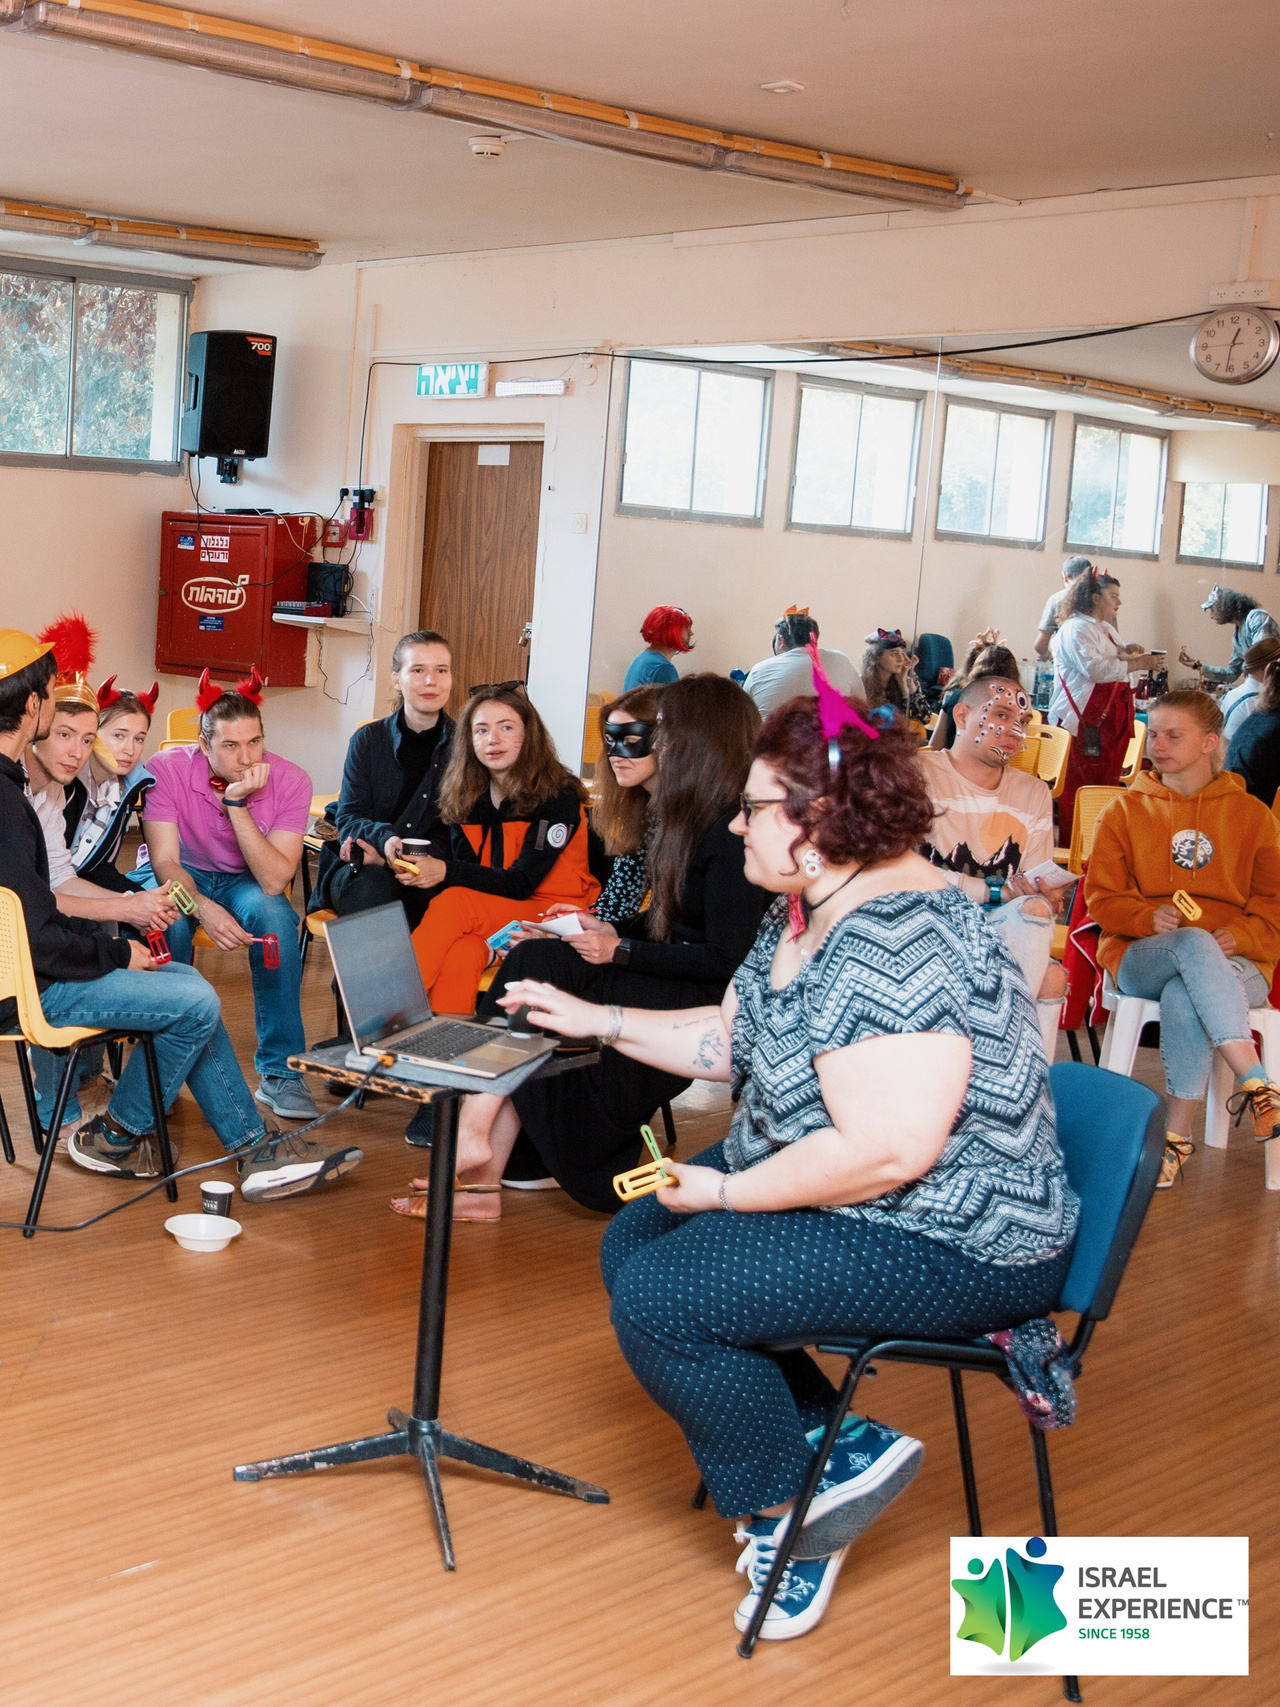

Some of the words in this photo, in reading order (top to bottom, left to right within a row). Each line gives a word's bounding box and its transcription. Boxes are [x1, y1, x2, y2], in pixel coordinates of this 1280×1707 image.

[1230, 316, 1240, 324] 12
[1206, 329, 1216, 338] 10
[251, 342, 271, 351] 700
[420, 364, 476, 395] יציאה
